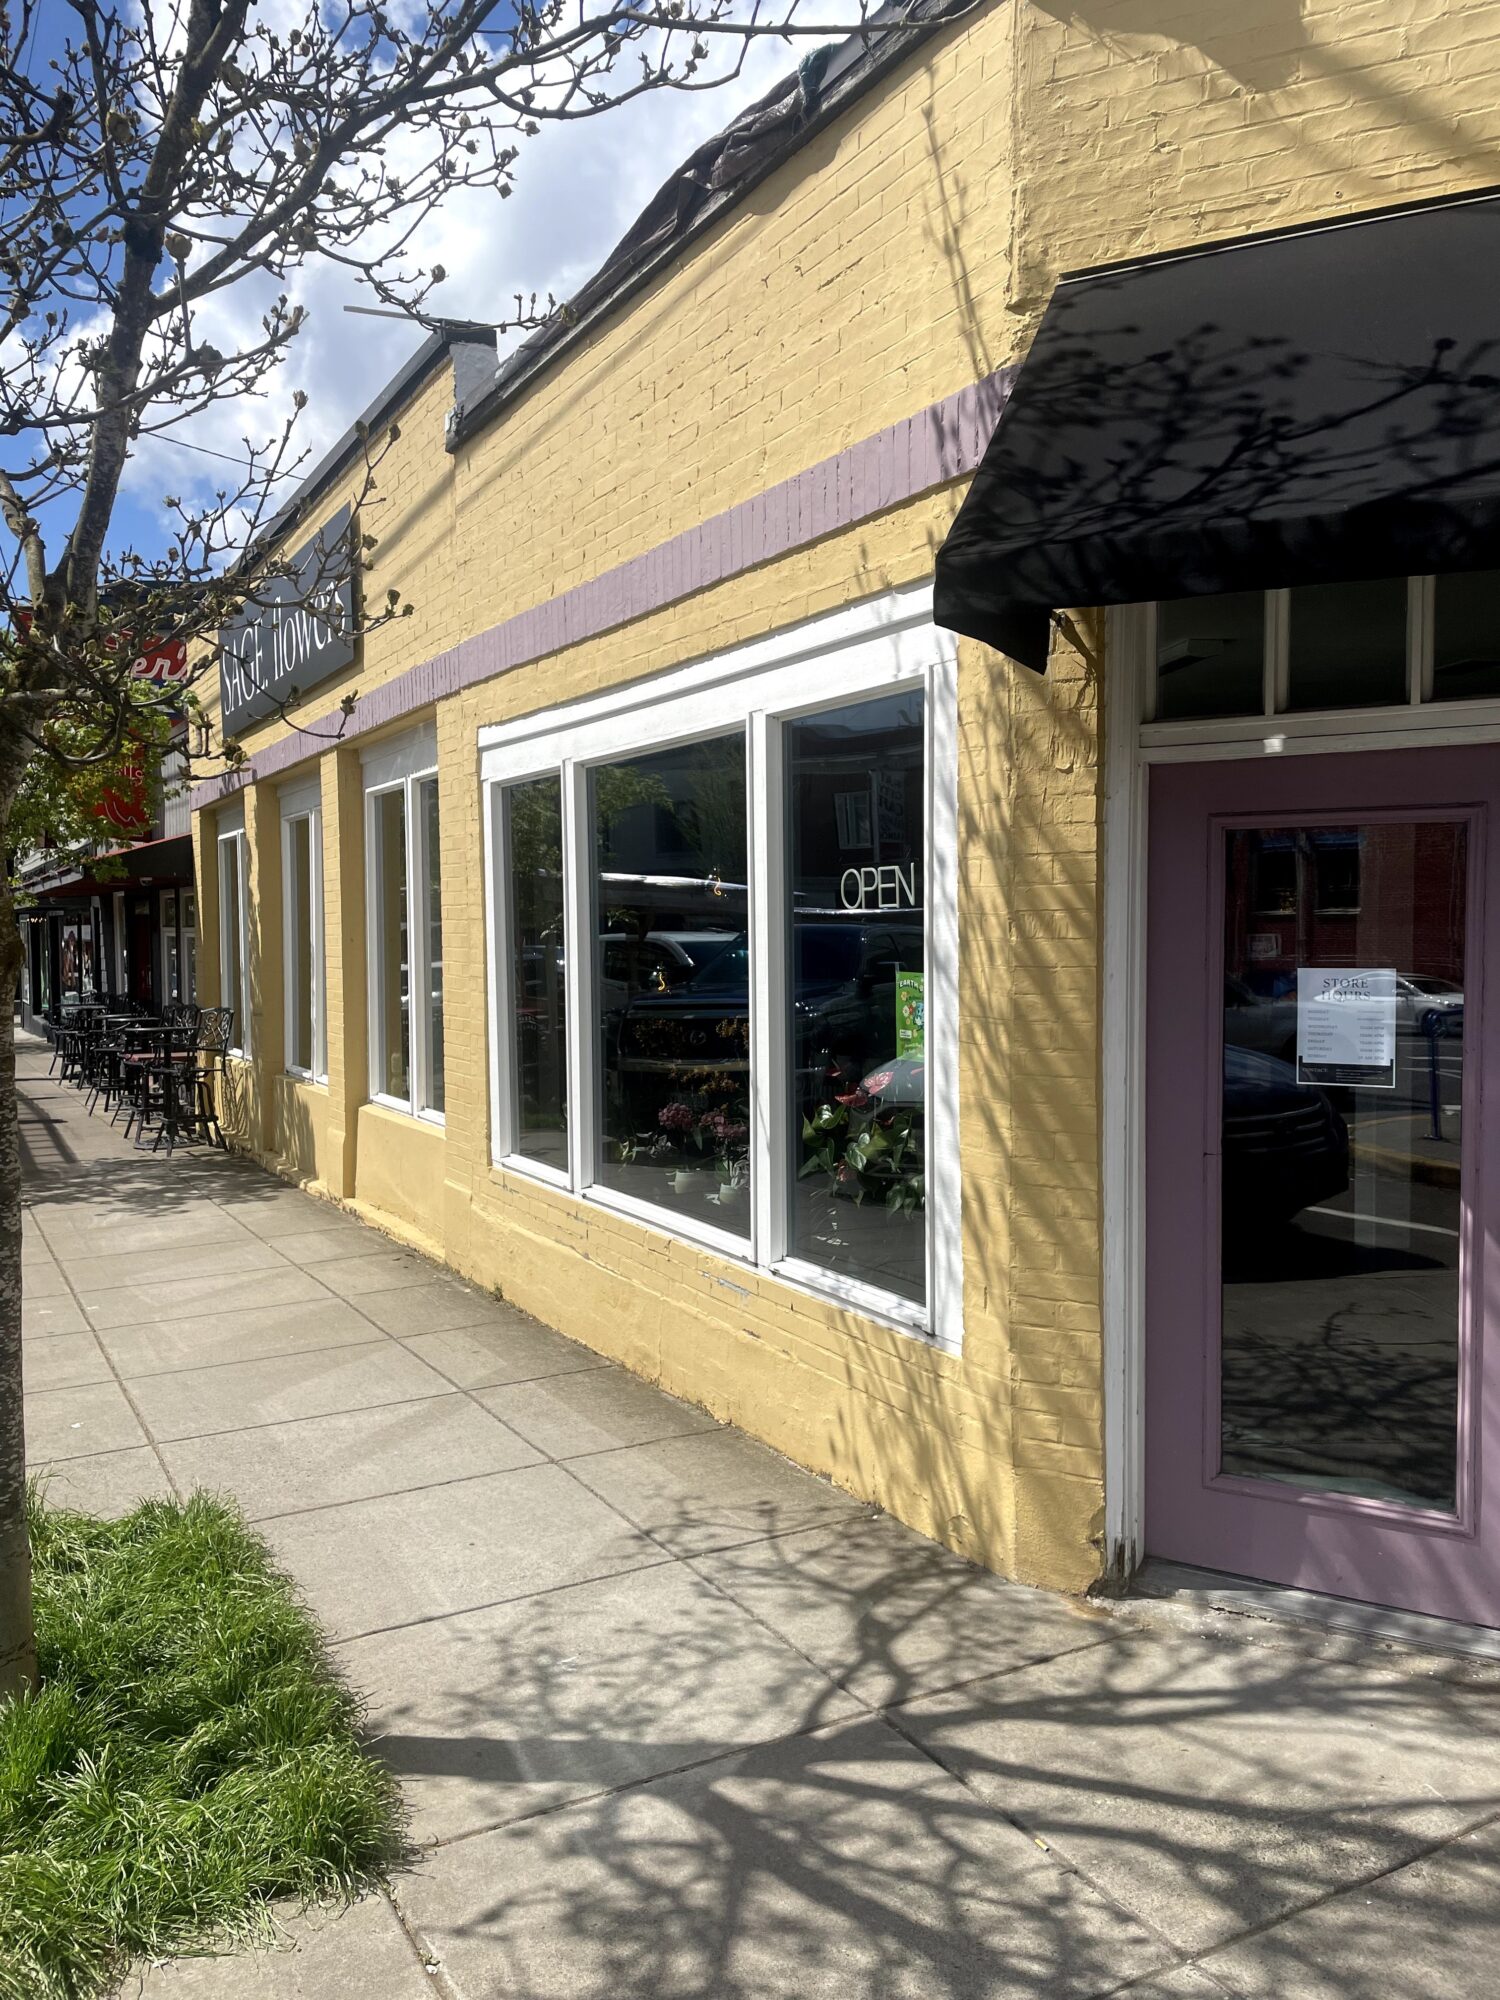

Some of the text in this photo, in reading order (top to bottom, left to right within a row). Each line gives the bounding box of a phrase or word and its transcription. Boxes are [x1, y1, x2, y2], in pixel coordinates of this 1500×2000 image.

[222, 617, 269, 715] SAGE
[841, 862, 915, 909] OPEN
[899, 978, 919, 990] EARTH
[1323, 978, 1369, 989] STORE
[1321, 990, 1371, 1001] HOURS
